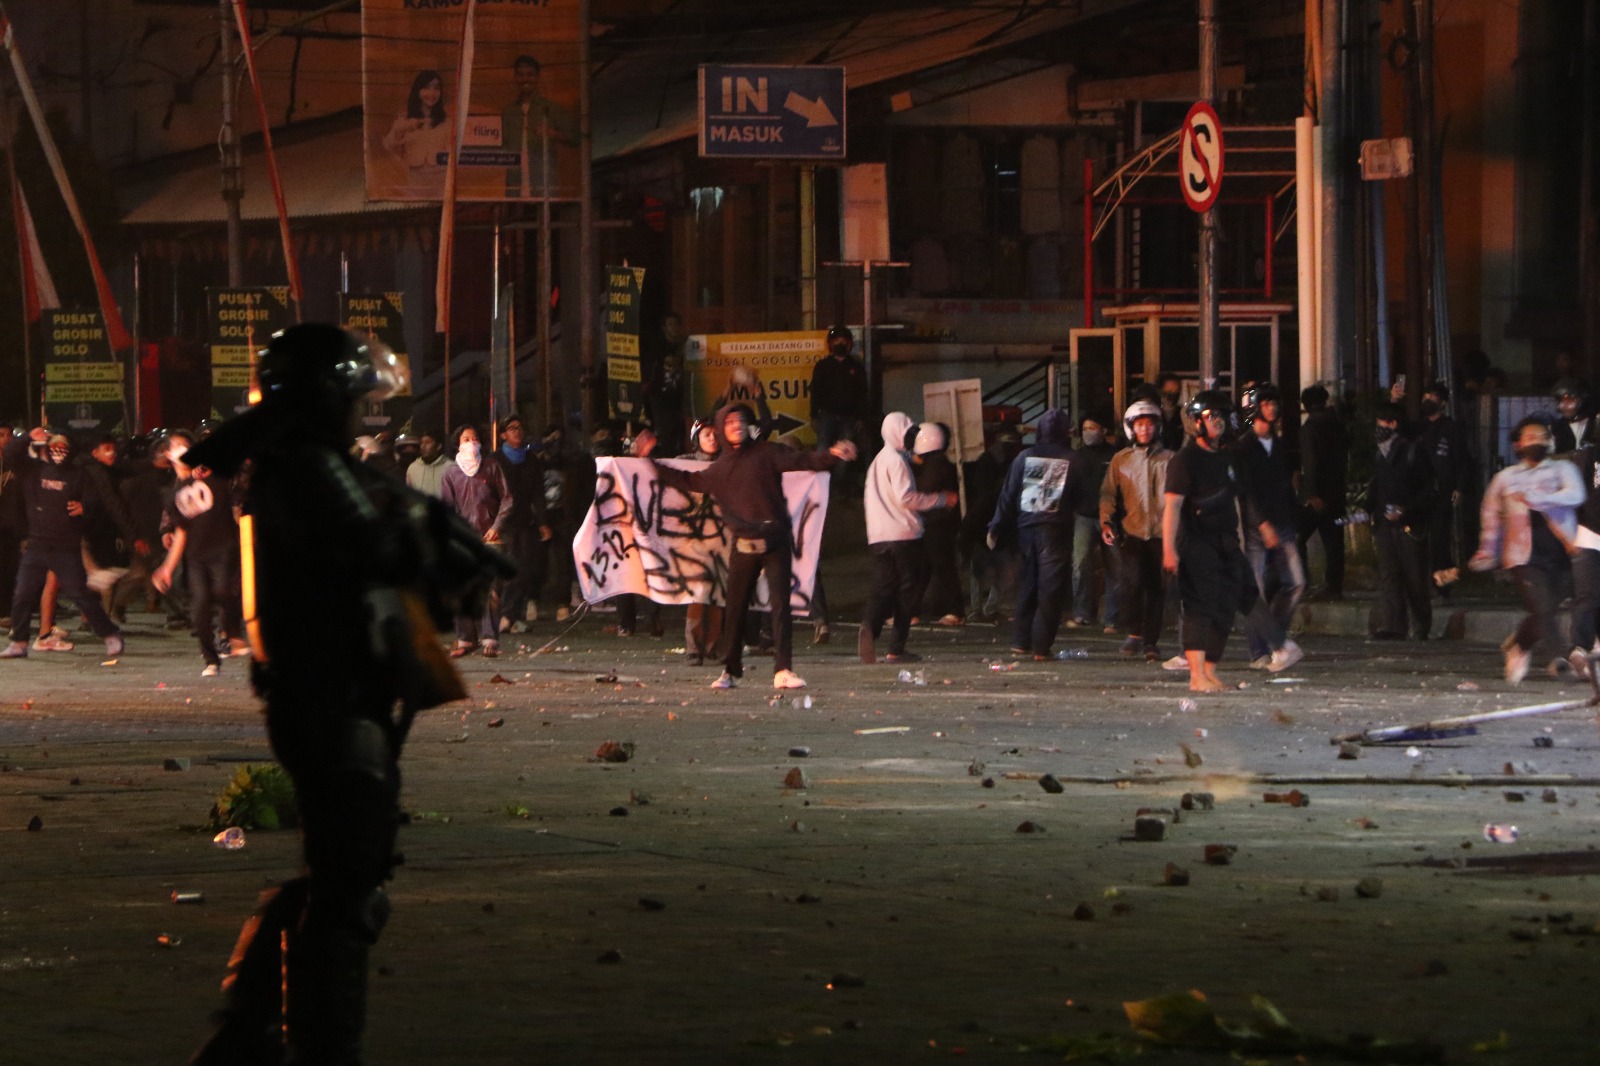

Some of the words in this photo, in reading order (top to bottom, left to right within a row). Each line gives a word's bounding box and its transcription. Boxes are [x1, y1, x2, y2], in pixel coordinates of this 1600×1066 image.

[721, 76, 769, 113] IN
[710, 125, 784, 143] MASUK
[218, 292, 263, 305] PUSAT
[348, 298, 383, 311] PUSAT
[52, 313, 97, 325] PUSAT
[218, 309, 270, 321] GROSIR
[52, 328, 103, 340] GROSIR
[219, 325, 255, 337] SOLO
[53, 343, 89, 356] SOLO
[730, 343, 766, 352] SELAMAT
[768, 341, 803, 350] DATANG
[805, 340, 815, 348] DI
[706, 356, 746, 367] PUSAT
[751, 354, 800, 366] GROSIR
